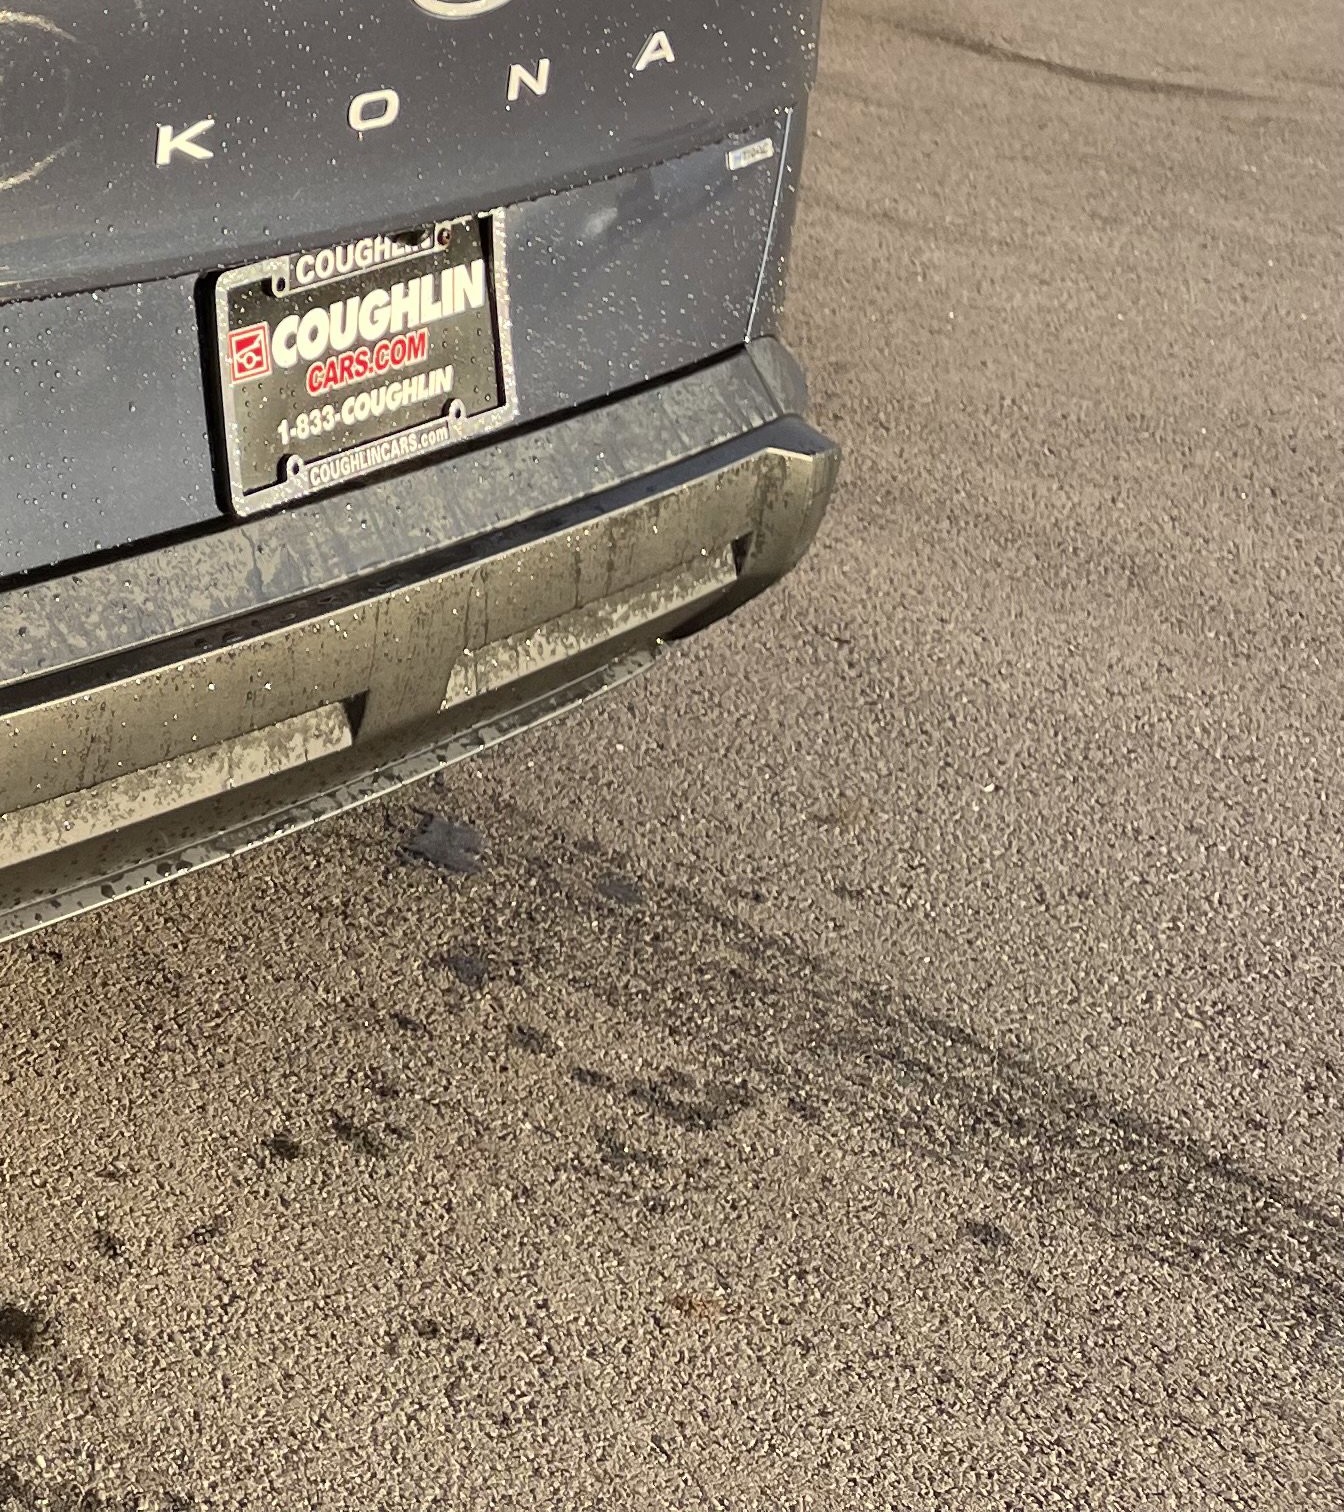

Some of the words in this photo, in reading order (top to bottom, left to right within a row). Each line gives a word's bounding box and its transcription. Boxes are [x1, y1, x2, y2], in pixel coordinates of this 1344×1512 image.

[156, 30, 675, 166] KONA
[271, 258, 487, 369] COUGHLIN
[307, 329, 429, 396] CARS.COM
[277, 364, 454, 446] 1-833-COUGHLIN
[309, 426, 450, 487] COUGHLINCARS.com
